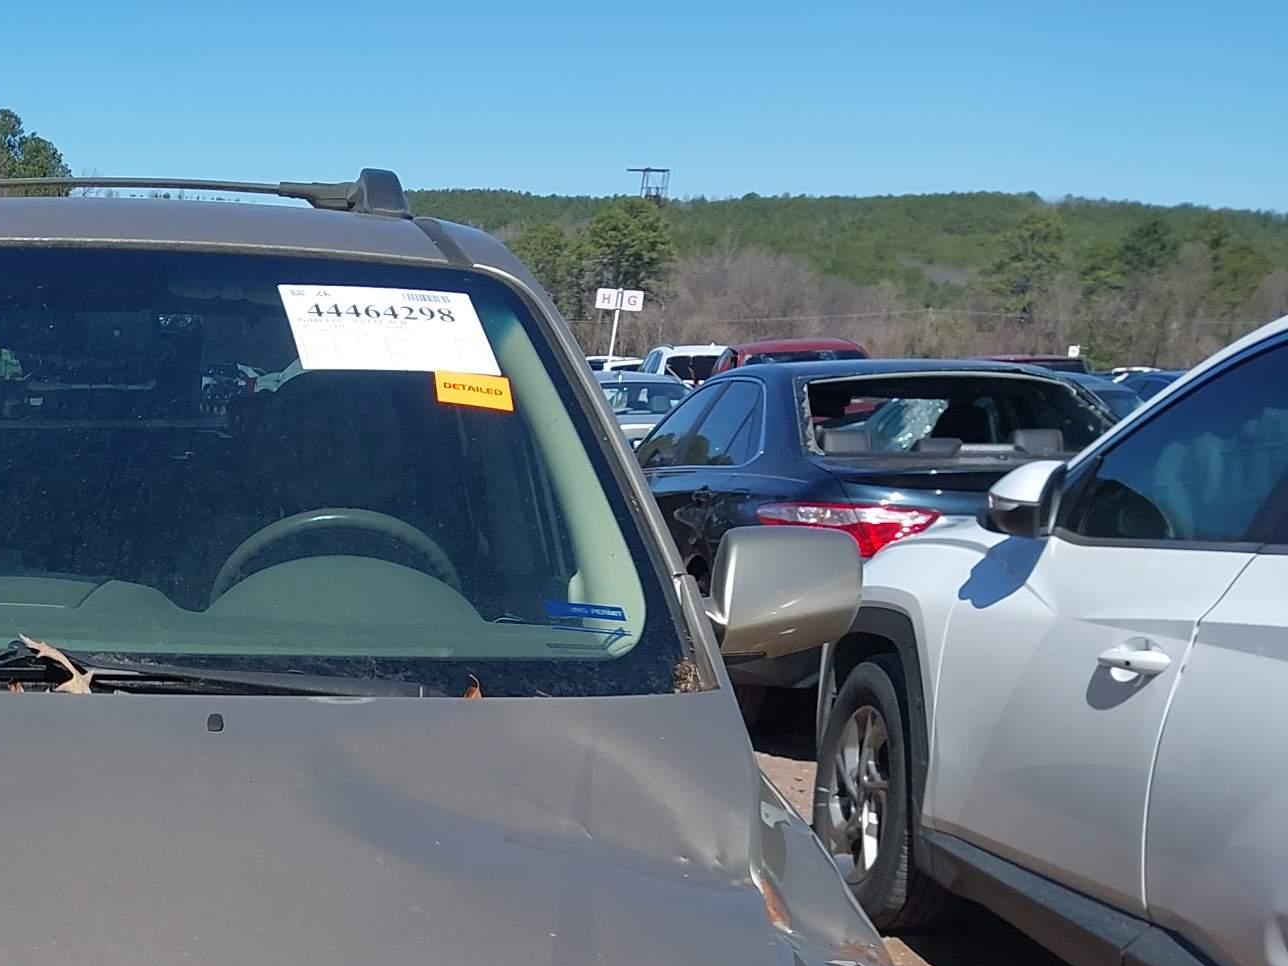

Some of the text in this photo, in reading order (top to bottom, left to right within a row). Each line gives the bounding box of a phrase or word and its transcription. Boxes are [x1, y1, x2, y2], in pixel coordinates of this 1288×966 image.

[601, 292, 612, 305] H
[627, 295, 638, 306] G
[306, 302, 456, 323] 44464298
[443, 381, 504, 397] DETAILED
